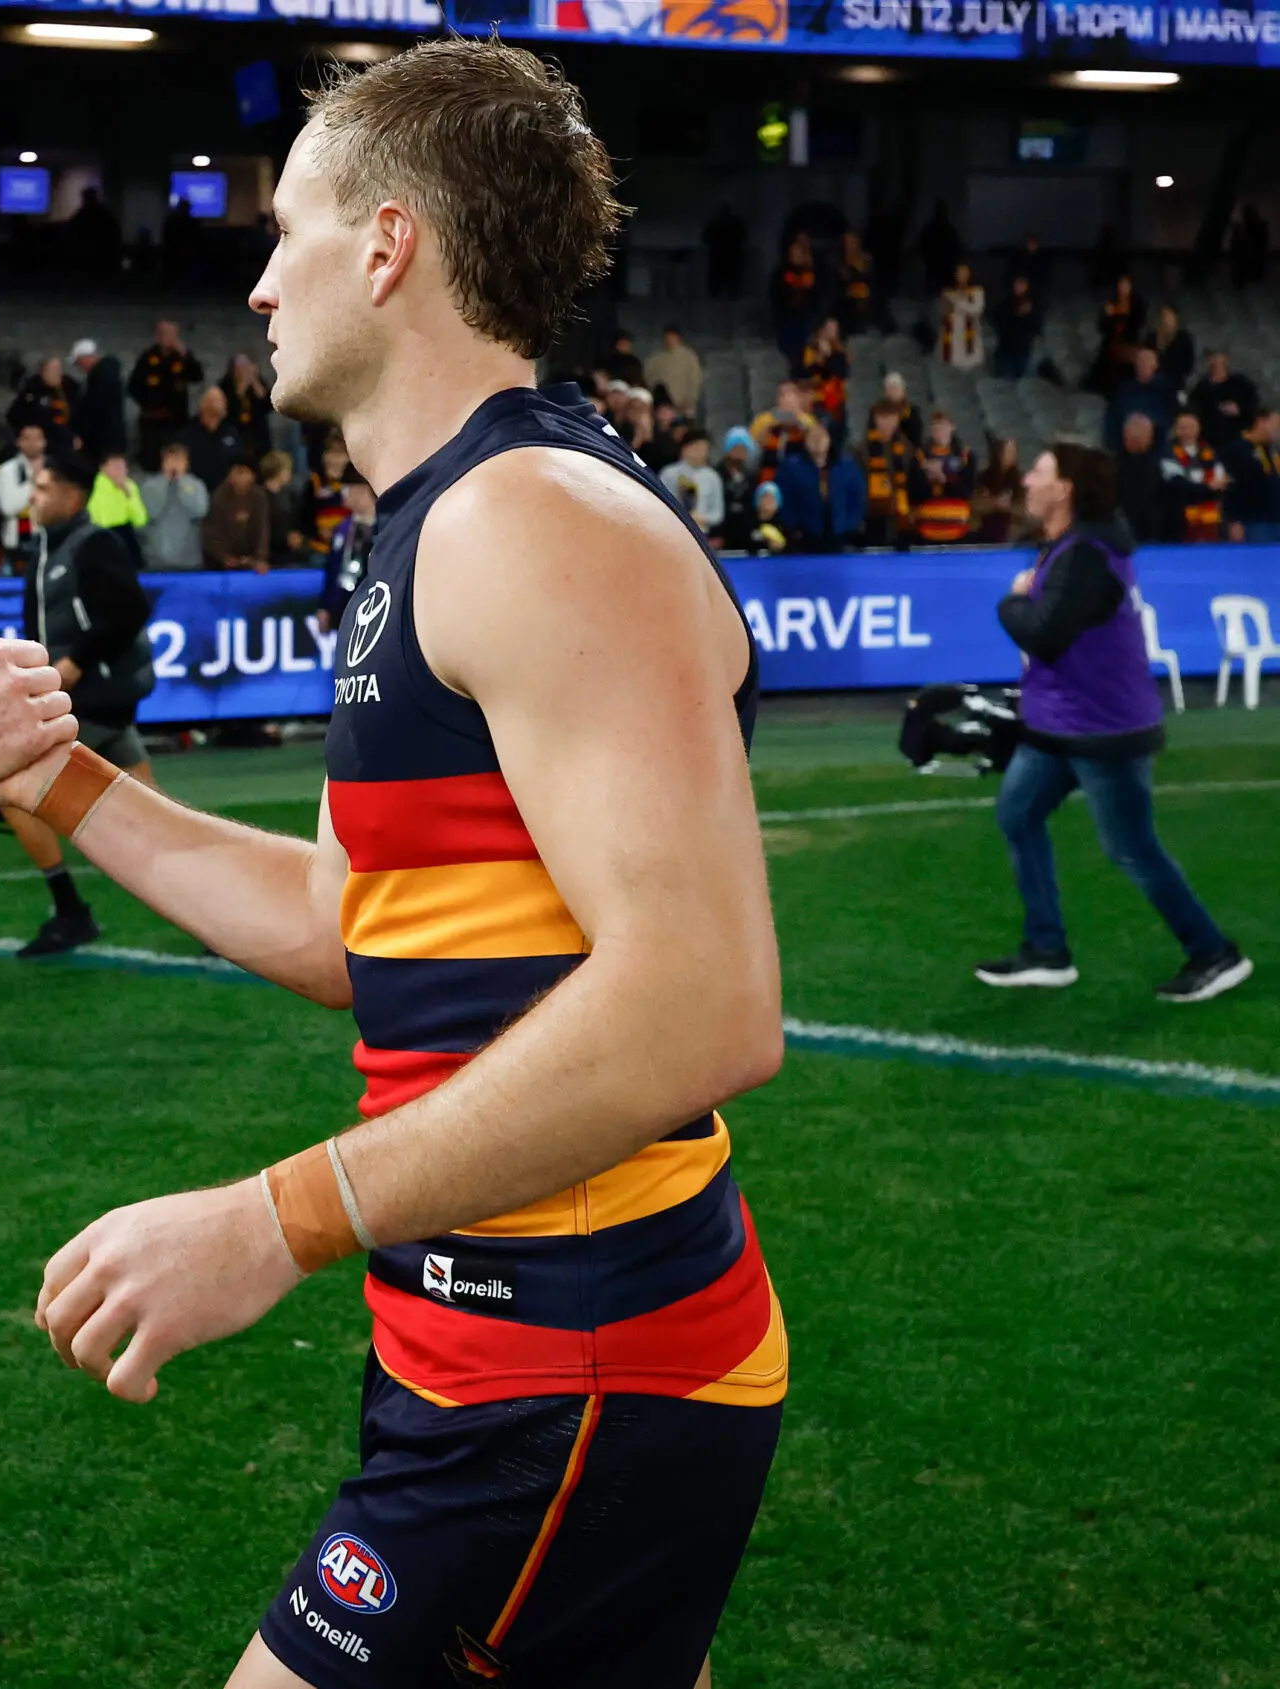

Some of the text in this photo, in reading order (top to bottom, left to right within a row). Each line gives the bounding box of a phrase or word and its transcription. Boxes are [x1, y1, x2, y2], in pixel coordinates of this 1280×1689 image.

[844, 0, 1031, 35] SUN 12 JULY
[201, 616, 337, 676] JULY
[320, 1541, 382, 1609] AFL
